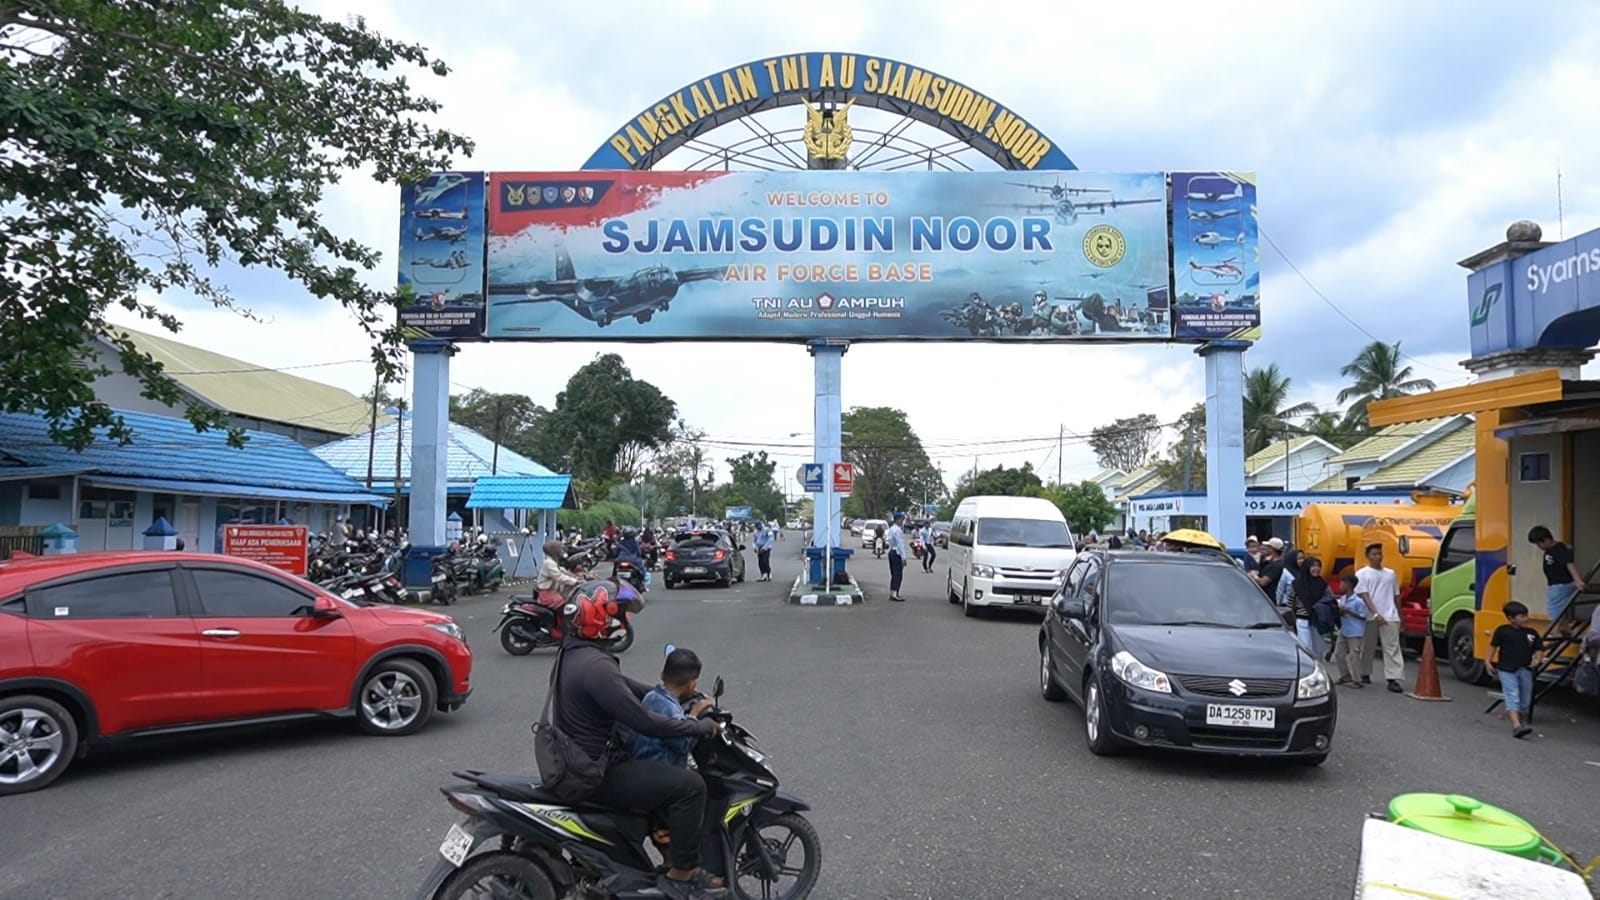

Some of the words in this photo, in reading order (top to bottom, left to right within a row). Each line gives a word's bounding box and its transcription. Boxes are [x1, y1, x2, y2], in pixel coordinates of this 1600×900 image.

[609, 65, 759, 166] PANGKALAN
[763, 55, 810, 94] TNI
[819, 53, 857, 89] AU
[863, 58, 997, 133] SJAMSUDIN
[984, 109, 1052, 170] NOOR
[767, 192, 860, 206] WELCOME
[865, 192, 889, 206] TO
[602, 217, 895, 252] SJAMSUDIN
[911, 217, 1054, 252] NOOR
[724, 264, 767, 281] AIR
[777, 264, 858, 281] FORCE
[868, 264, 933, 281] BASE
[752, 297, 782, 309] TNI
[787, 297, 813, 309] AU
[837, 297, 905, 309] AMPUH
[1271, 501, 1303, 510] JAGA
[1209, 706, 1222, 719] DA
[1223, 707, 1252, 720] 1258
[1253, 709, 1273, 722] TPJ
